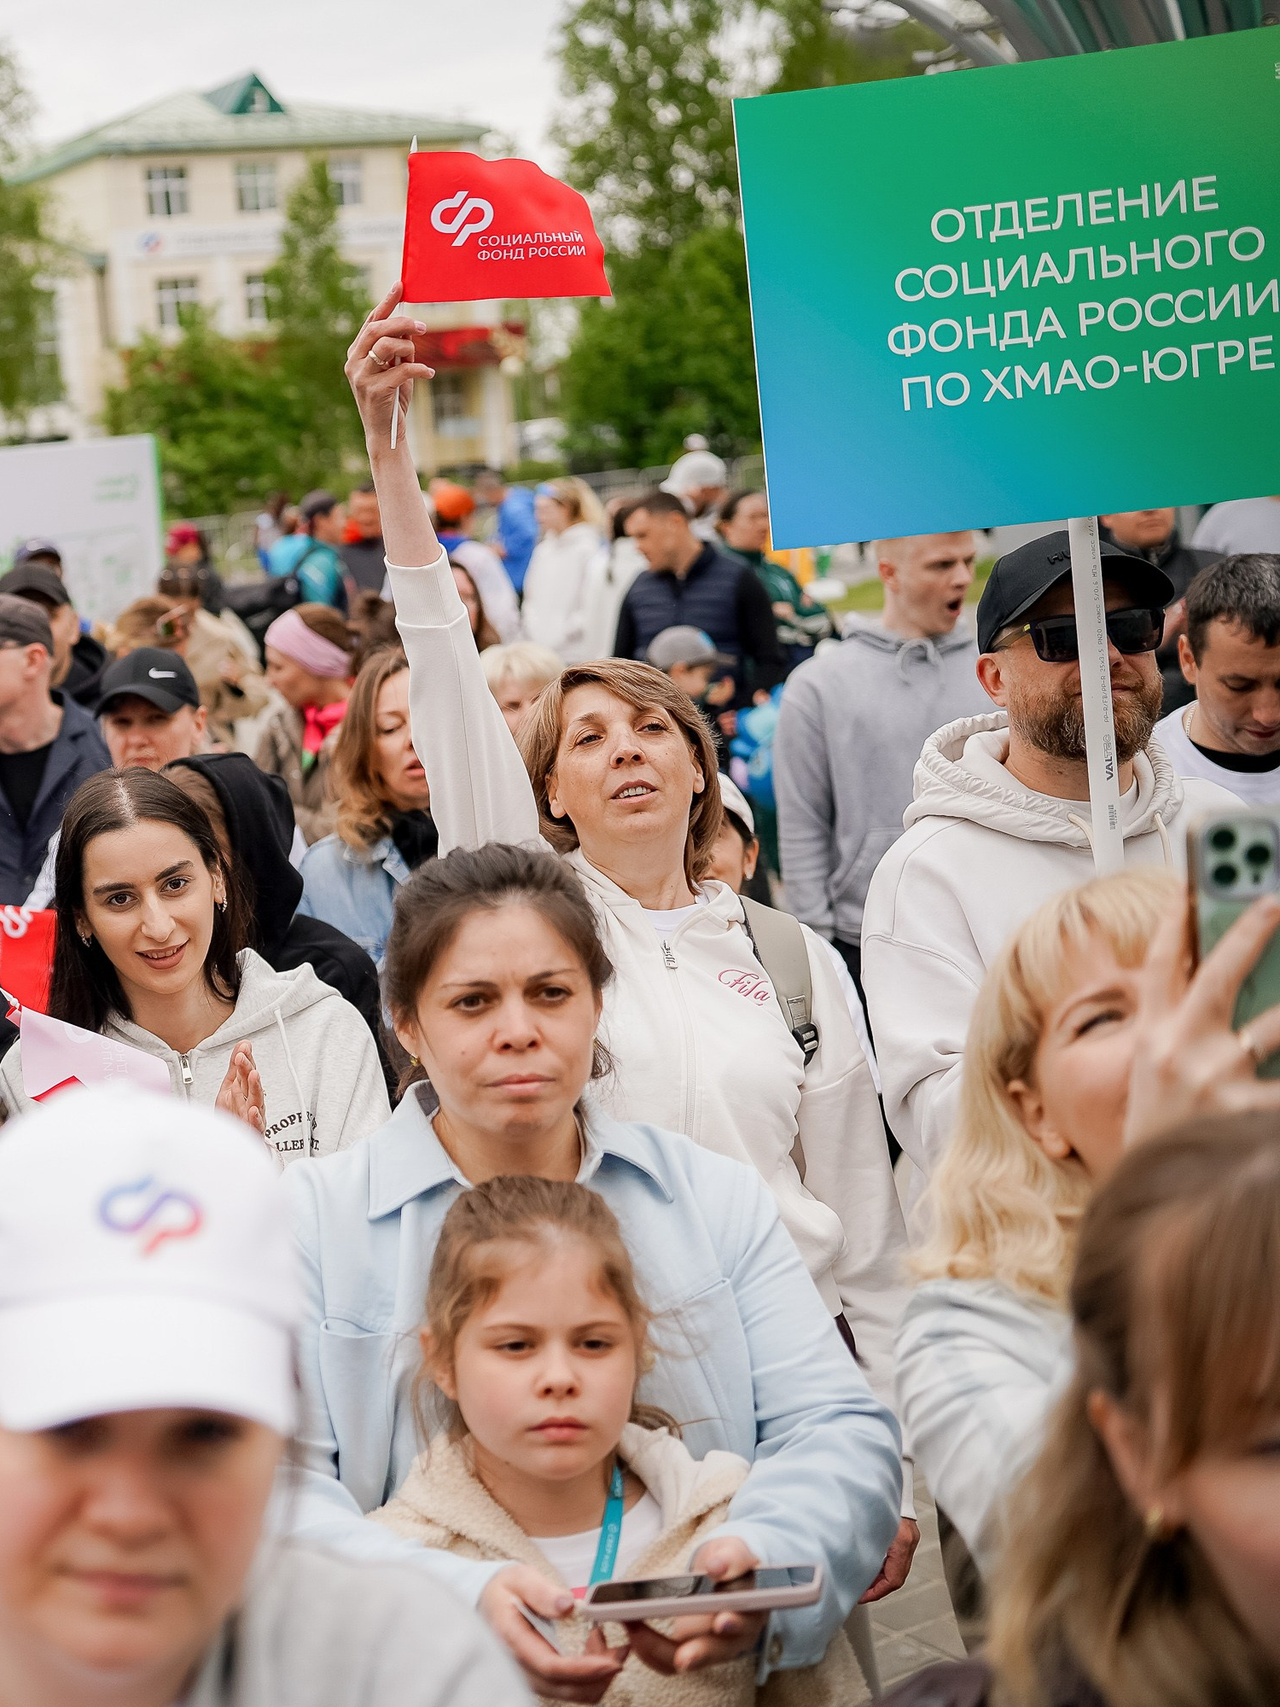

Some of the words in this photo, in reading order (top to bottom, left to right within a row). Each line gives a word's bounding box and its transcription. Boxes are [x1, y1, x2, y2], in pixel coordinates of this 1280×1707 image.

[930, 174, 1219, 243] ОТДЕЛЕНИЕ
[477, 247, 525, 261] ФОНД
[528, 245, 586, 258] РОССИИ
[478, 230, 584, 247] СОЦИАЛЬНЫЙ
[894, 226, 1266, 302] СОЦИАЛЬНОГО
[887, 306, 1067, 357] ФОНДА
[1078, 278, 1280, 337] РОССИИ
[901, 372, 971, 411] ПО
[981, 335, 1276, 402] ХМАО-ЮГРЕ
[1104, 733, 1115, 781] VALTEC
[718, 968, 770, 1007] Fila
